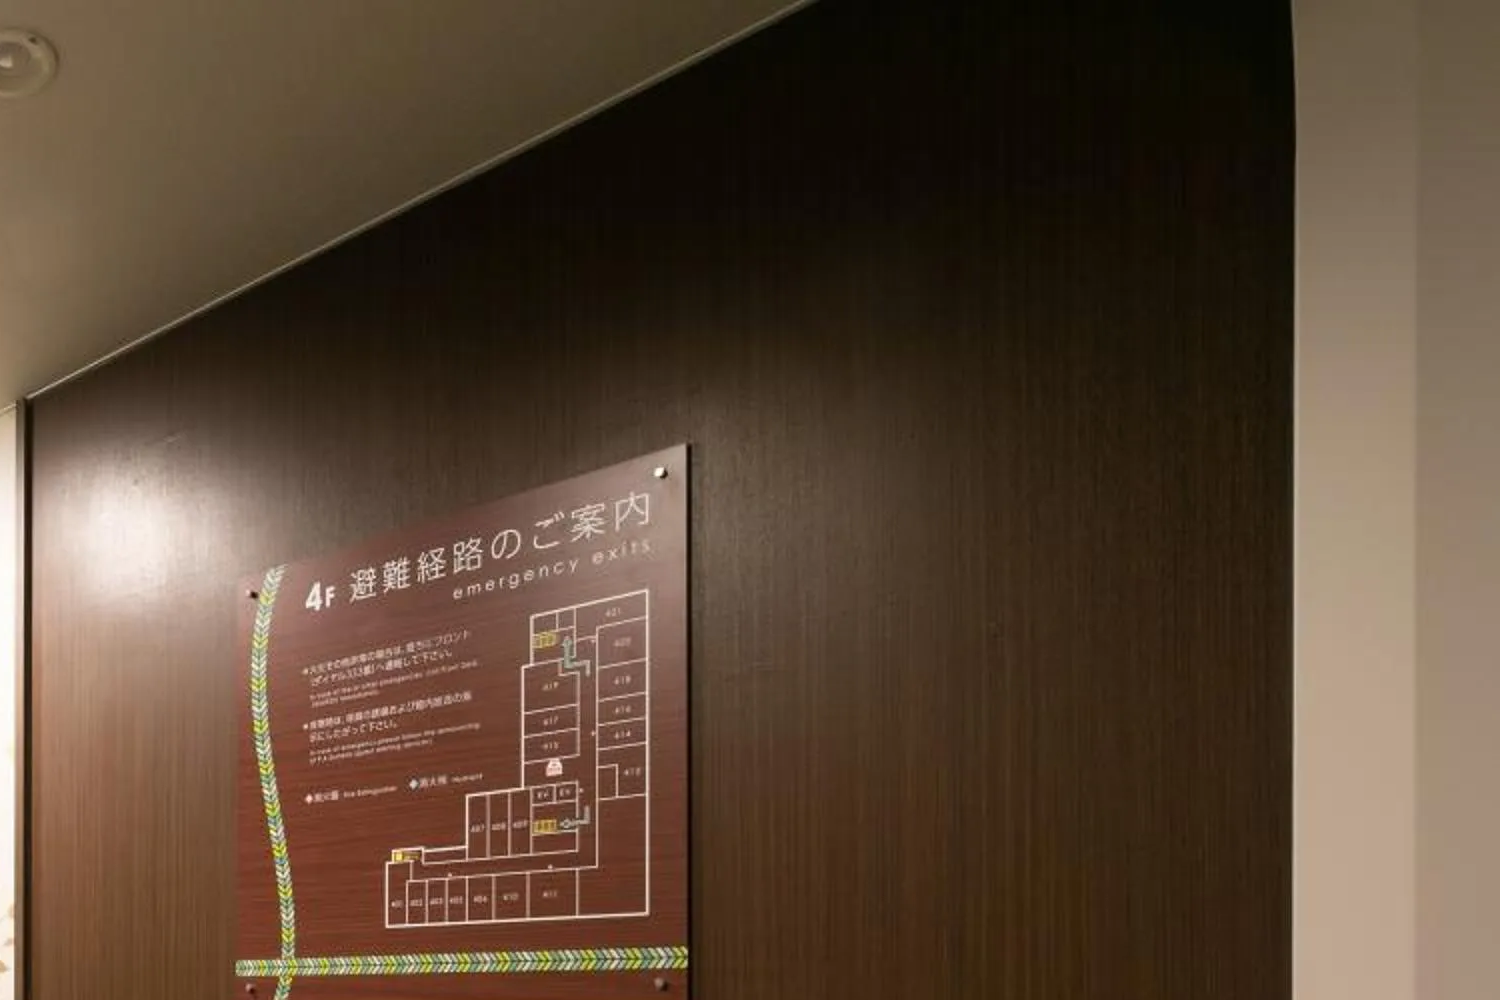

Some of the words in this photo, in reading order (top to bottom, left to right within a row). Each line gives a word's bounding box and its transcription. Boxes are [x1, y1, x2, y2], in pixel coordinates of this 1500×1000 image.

[305, 580, 335, 611] 4F
[350, 491, 650, 603] 避難経路のご案内
[452, 557, 579, 600] emergency
[592, 538, 651, 565] exits
